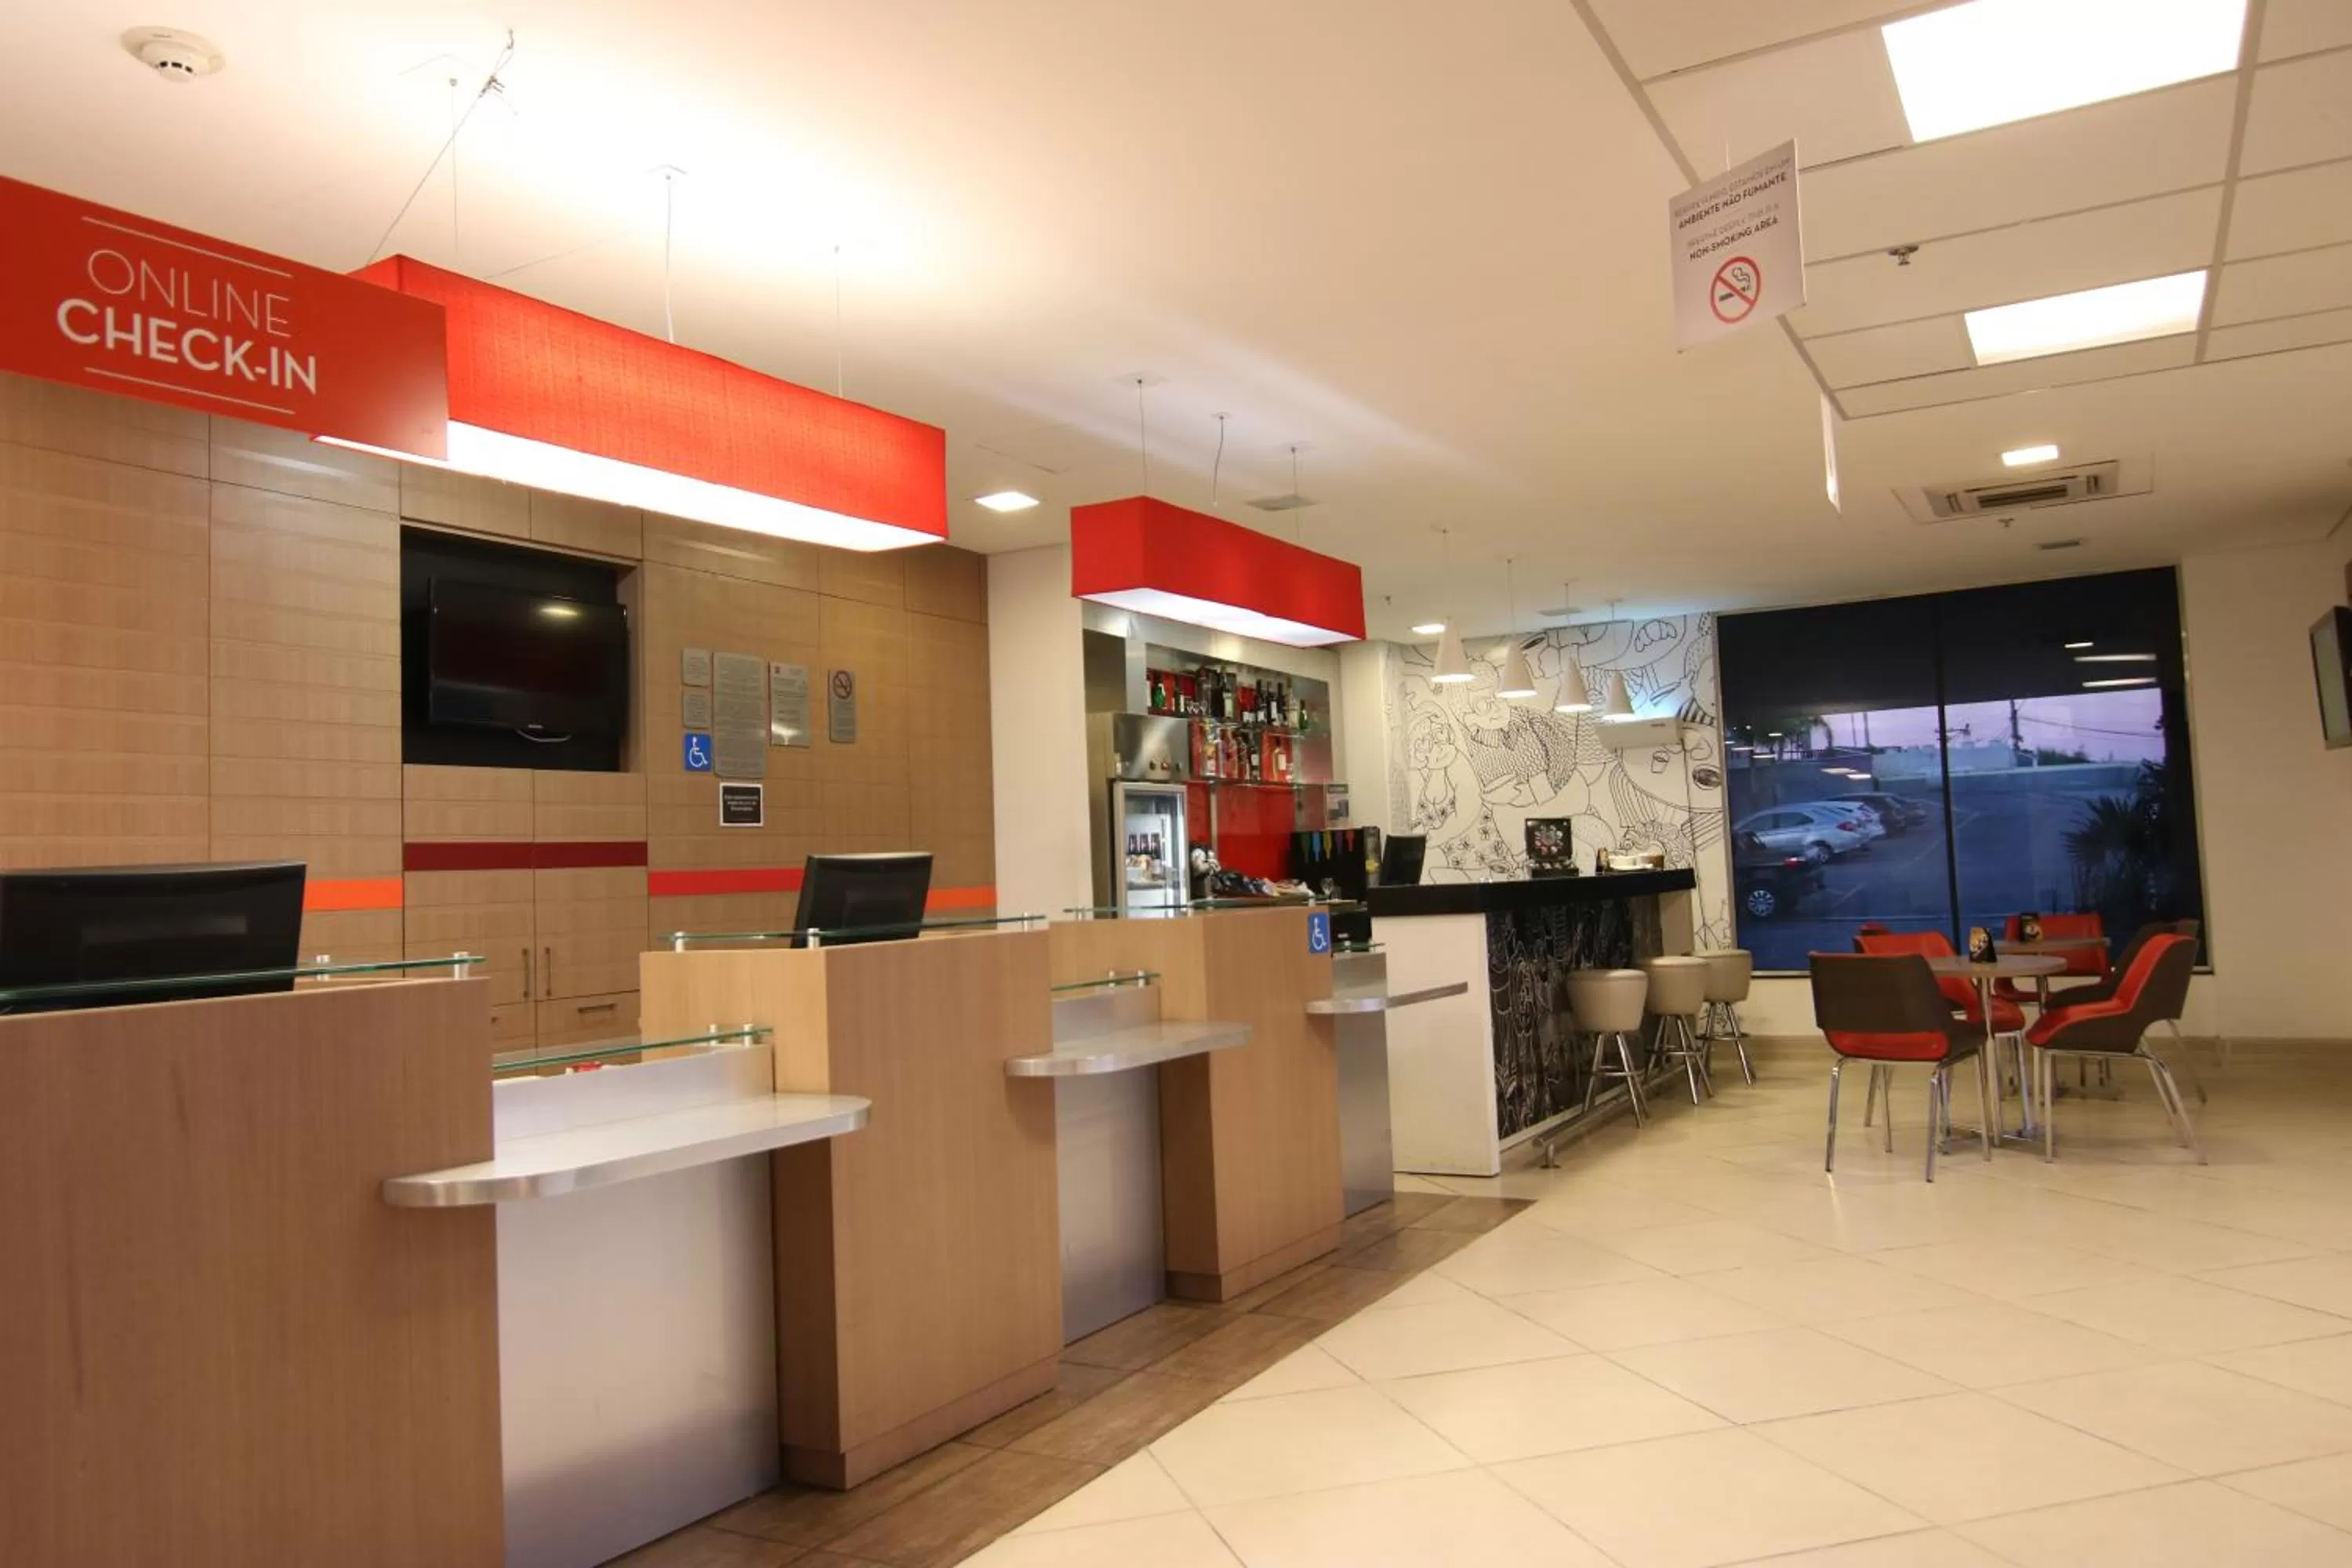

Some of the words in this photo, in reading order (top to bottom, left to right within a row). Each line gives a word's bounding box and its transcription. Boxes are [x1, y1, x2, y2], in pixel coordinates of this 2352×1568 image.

[1679, 202, 1720, 230] AMBIENTE
[1722, 193, 1741, 209] NÃO
[1743, 172, 1788, 200] FUMANTE
[1754, 215, 1778, 233] AREA
[87, 249, 292, 338] ONLINE
[56, 299, 317, 395] CHECK-IN
